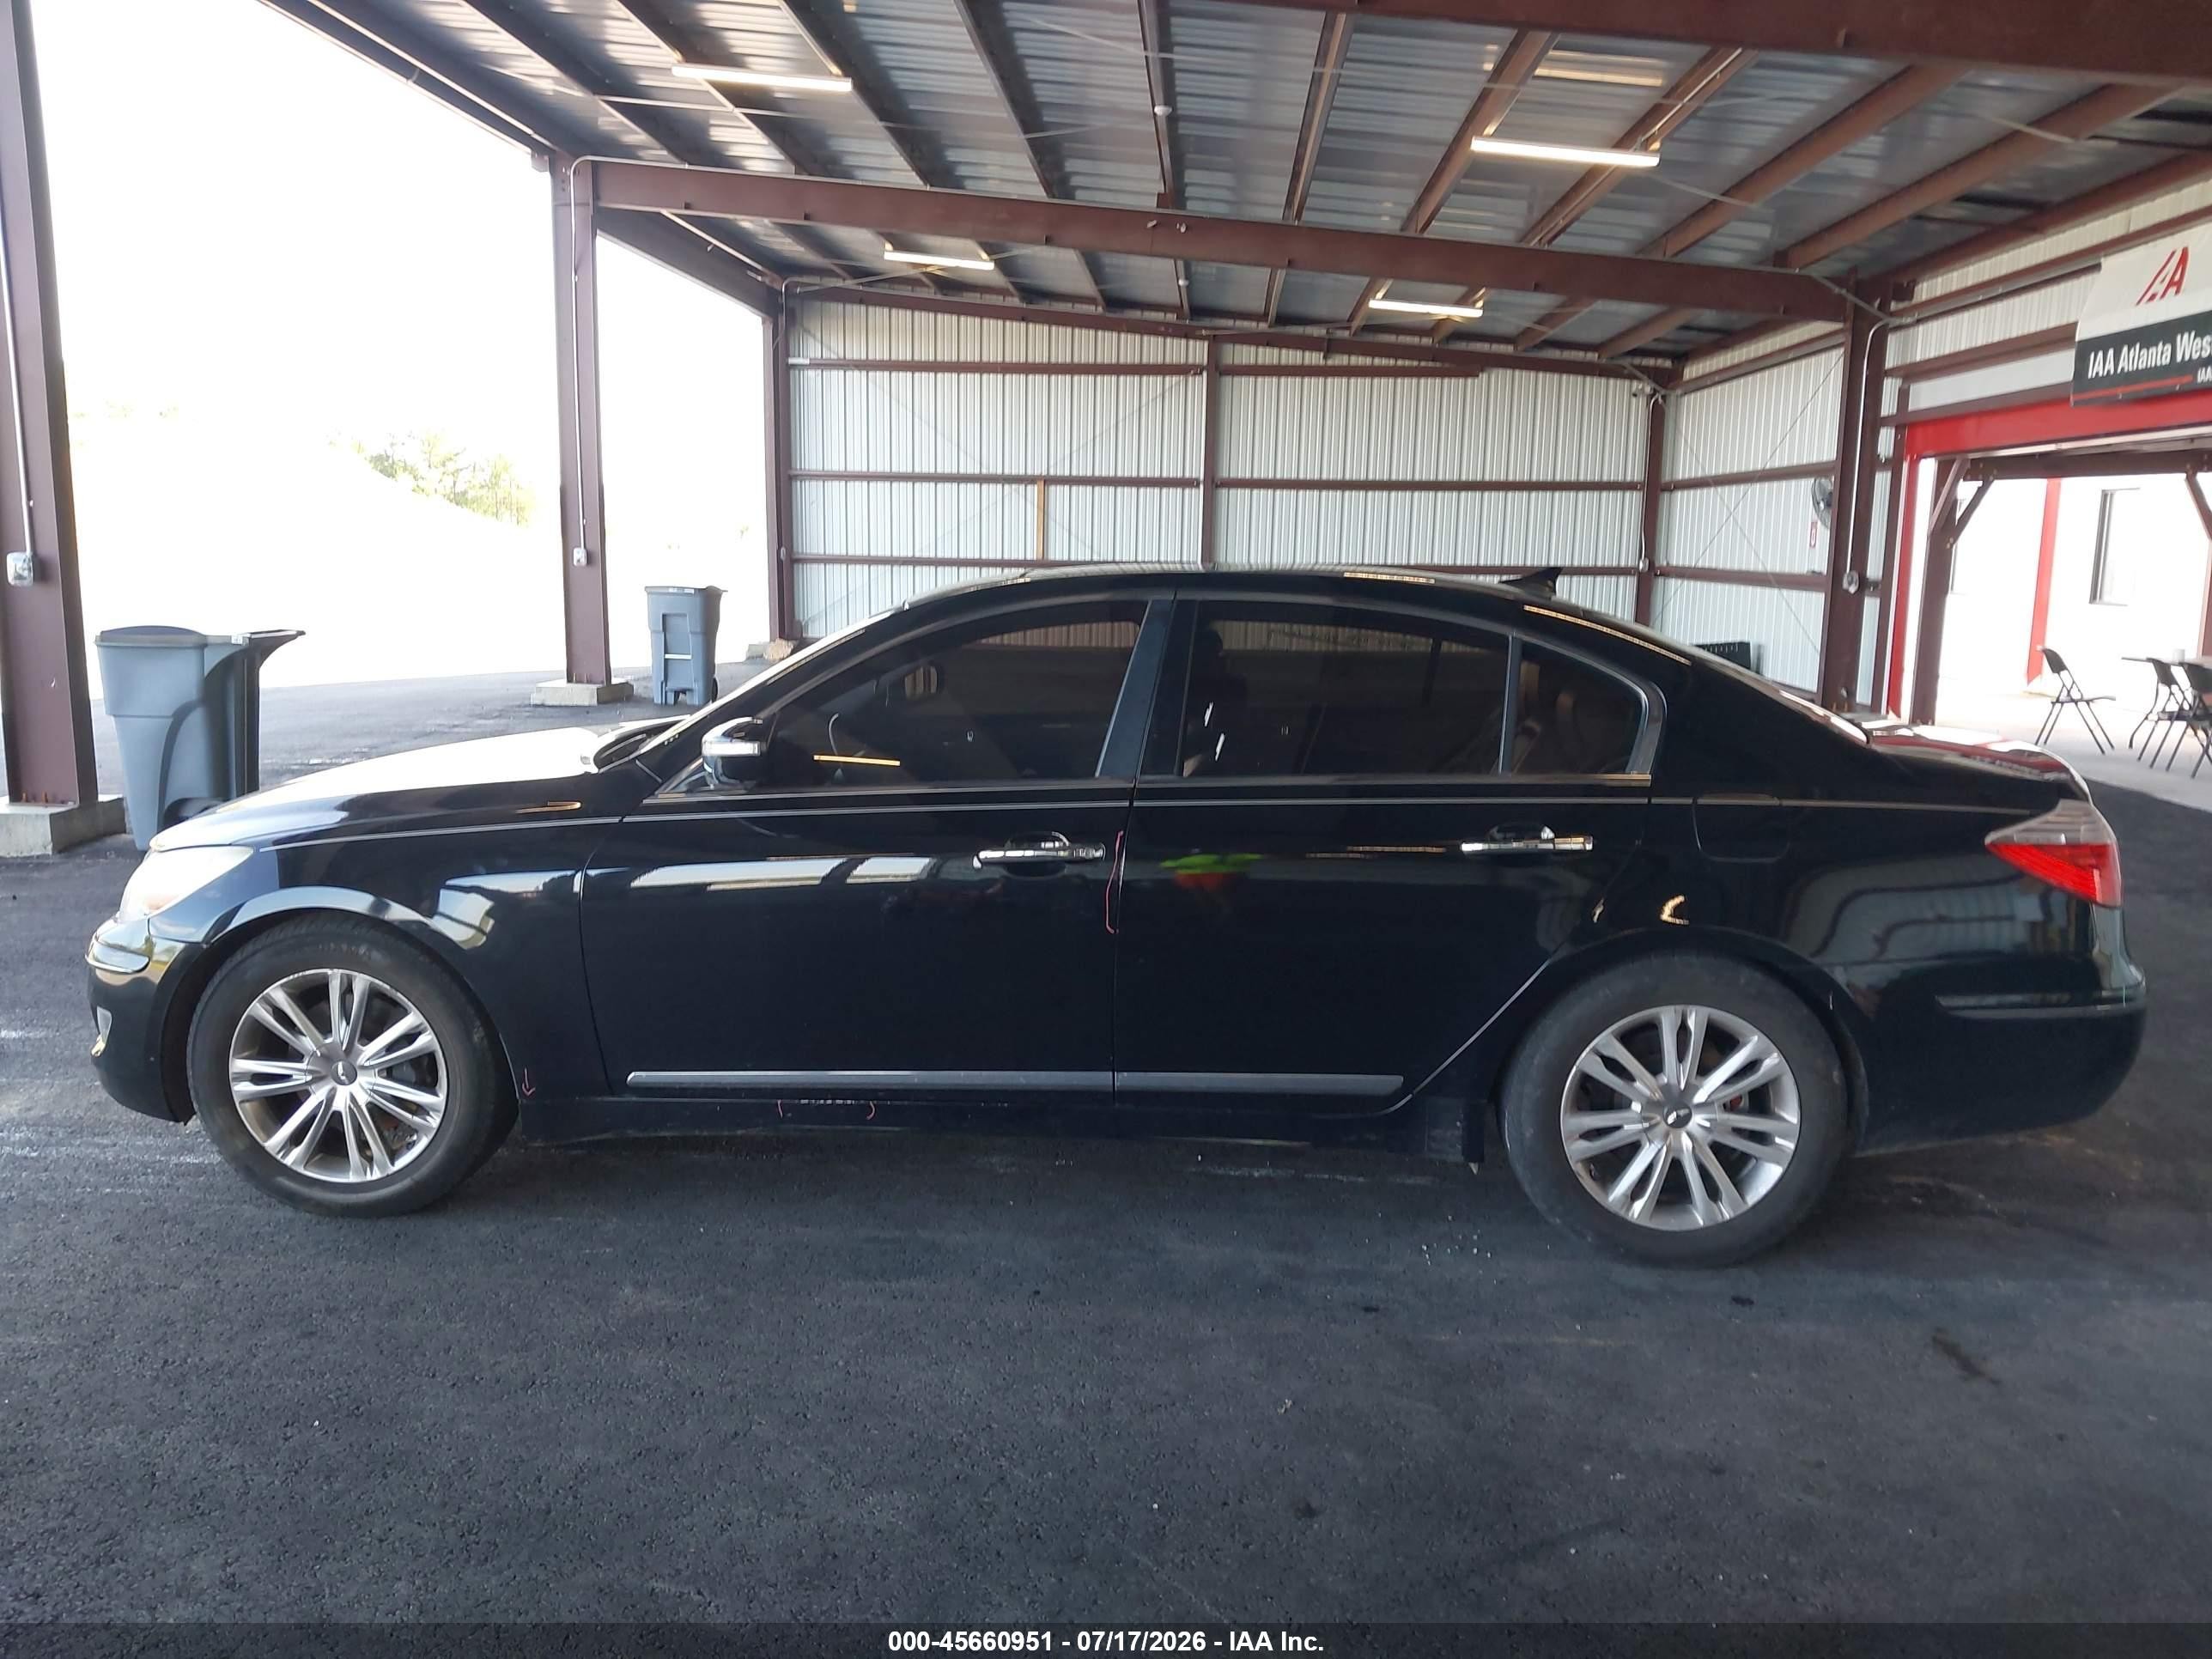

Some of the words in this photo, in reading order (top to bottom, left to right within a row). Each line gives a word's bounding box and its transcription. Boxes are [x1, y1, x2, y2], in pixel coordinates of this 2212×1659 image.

[2087, 348, 2115, 379] IAA
[2117, 341, 2172, 374] Atlanta
[2175, 330, 2212, 363] Wes
